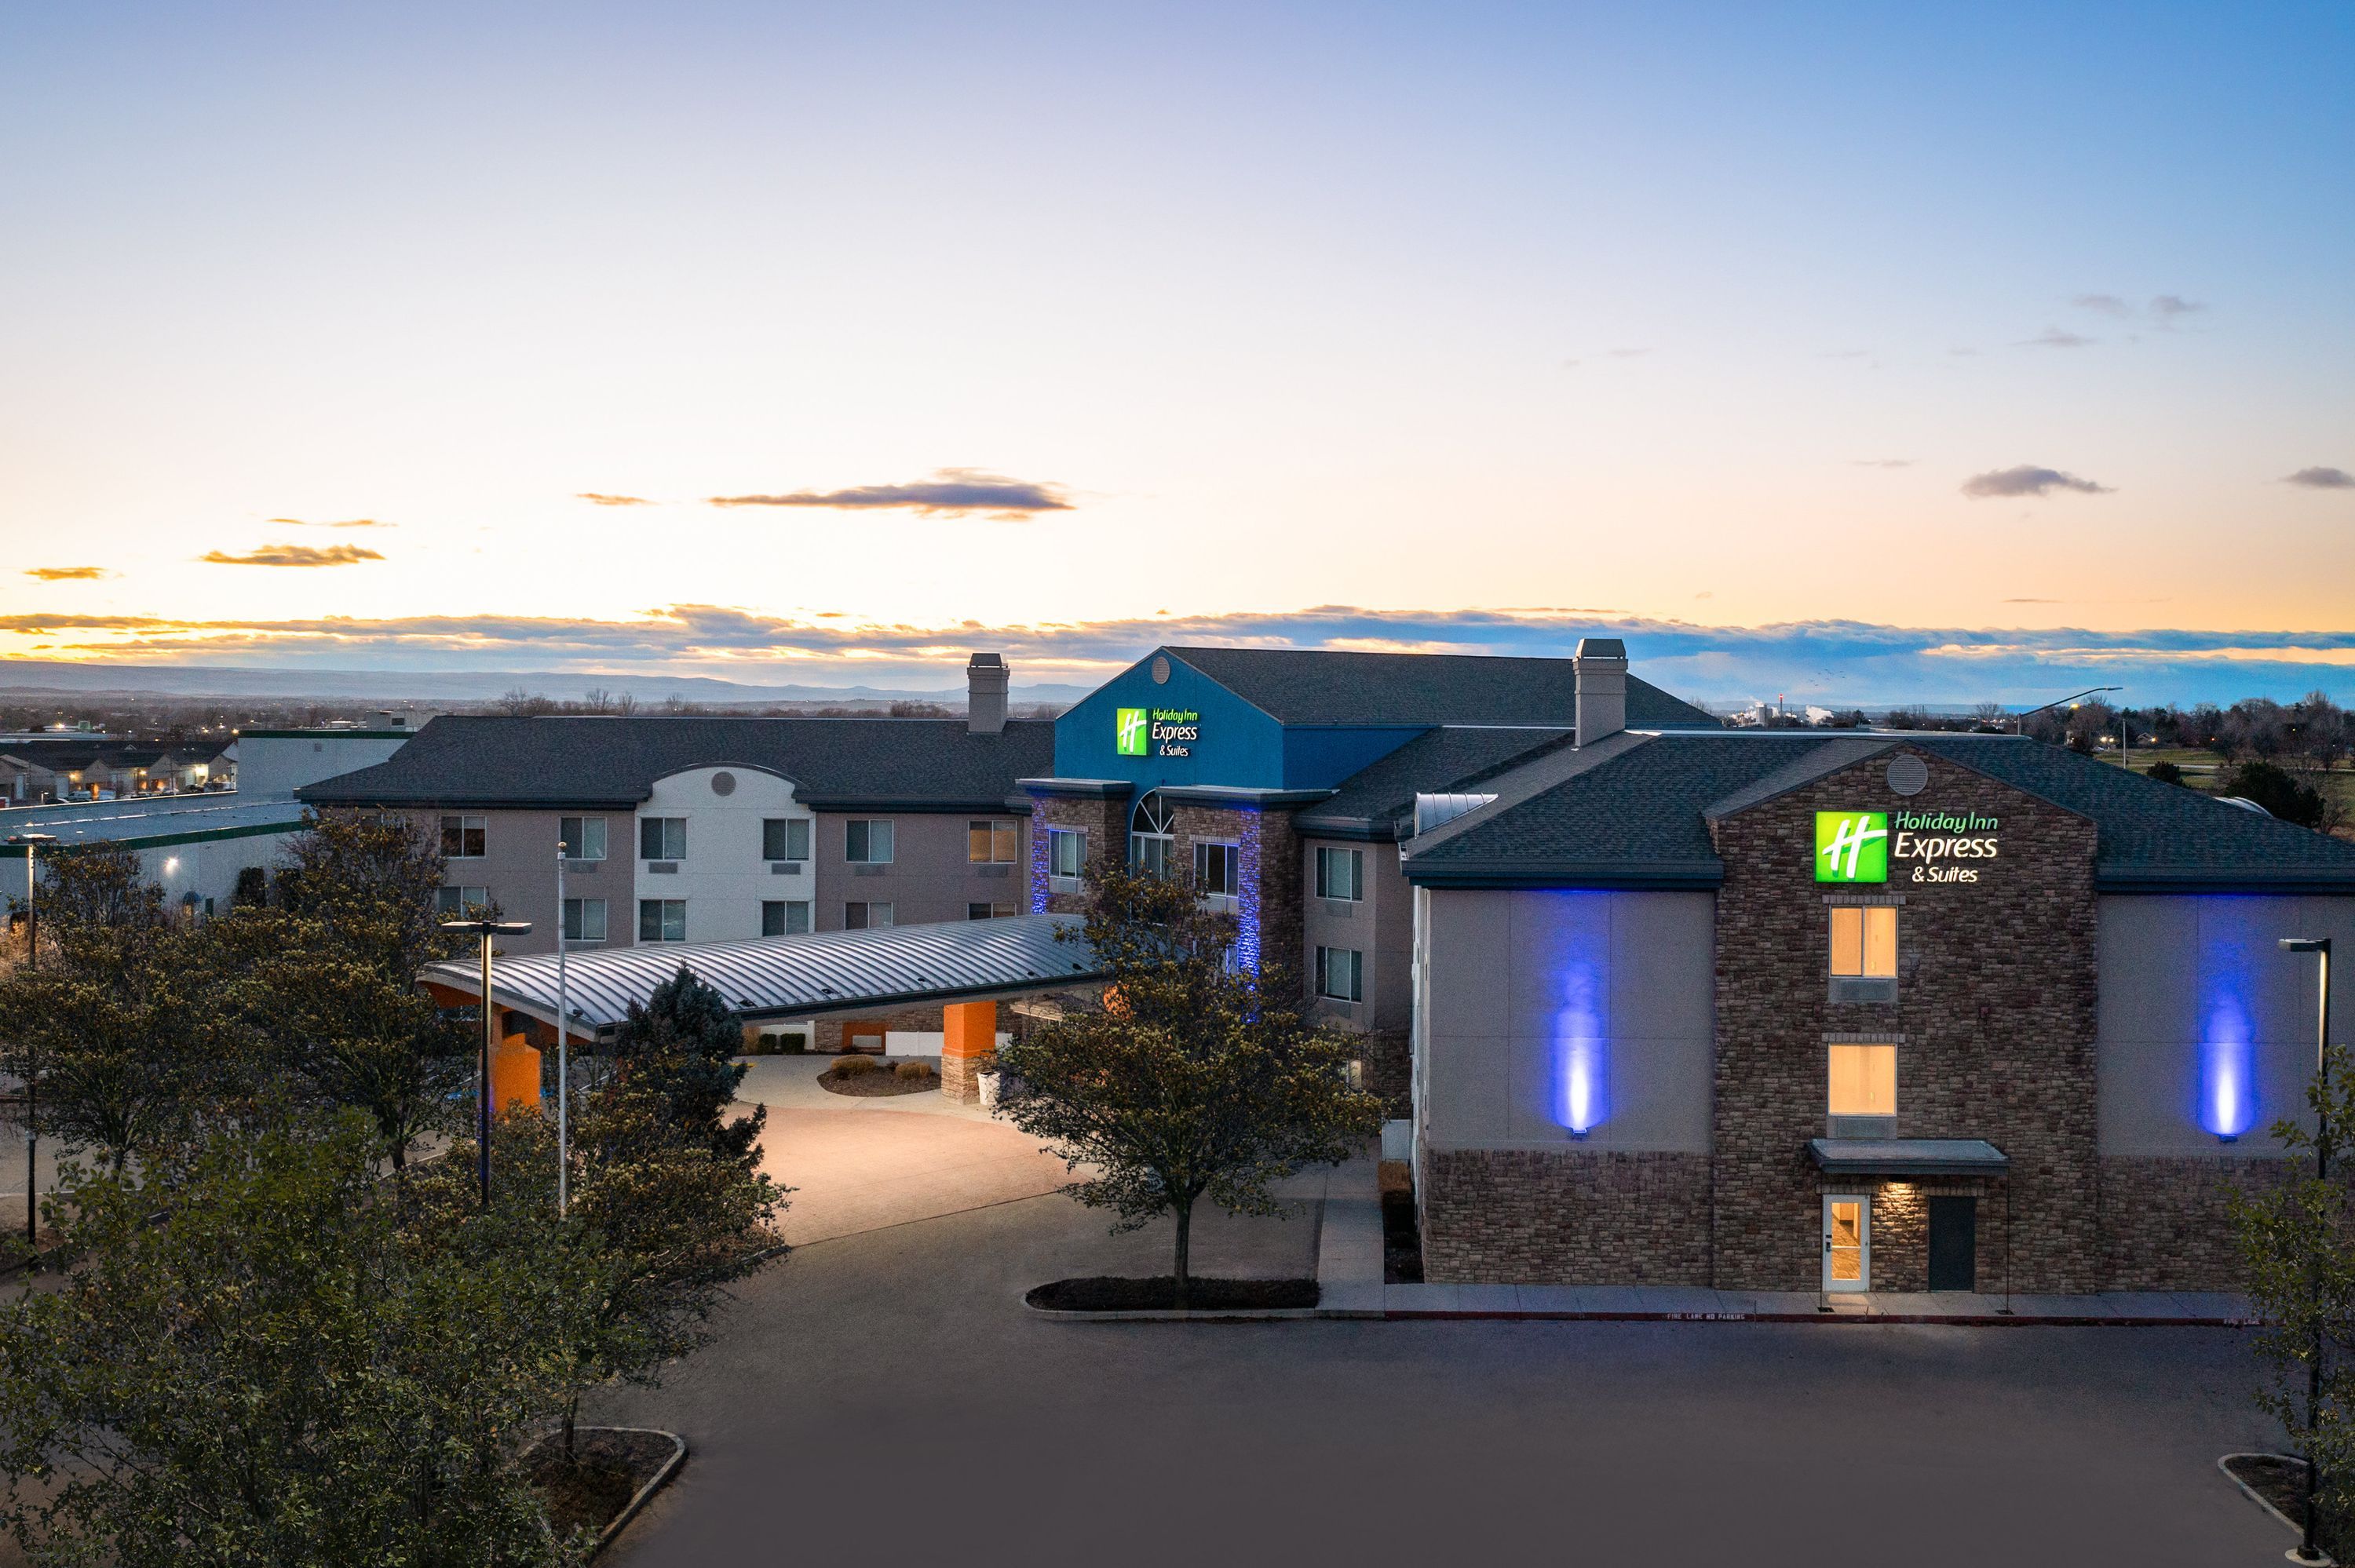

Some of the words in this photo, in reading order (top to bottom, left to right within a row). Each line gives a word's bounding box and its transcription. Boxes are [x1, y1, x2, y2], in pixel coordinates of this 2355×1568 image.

[1152, 708, 1184, 724] Holiday
[1184, 708, 1198, 721] Inn
[1152, 722, 1198, 744] Express
[1159, 744, 1166, 756] &
[1166, 745, 1188, 757] Suites
[1893, 811, 1967, 834] Holiday
[1969, 811, 1999, 830] Inn
[1893, 832, 1998, 865] Express
[1911, 866, 1925, 882] &
[1926, 866, 1978, 883] Suites
